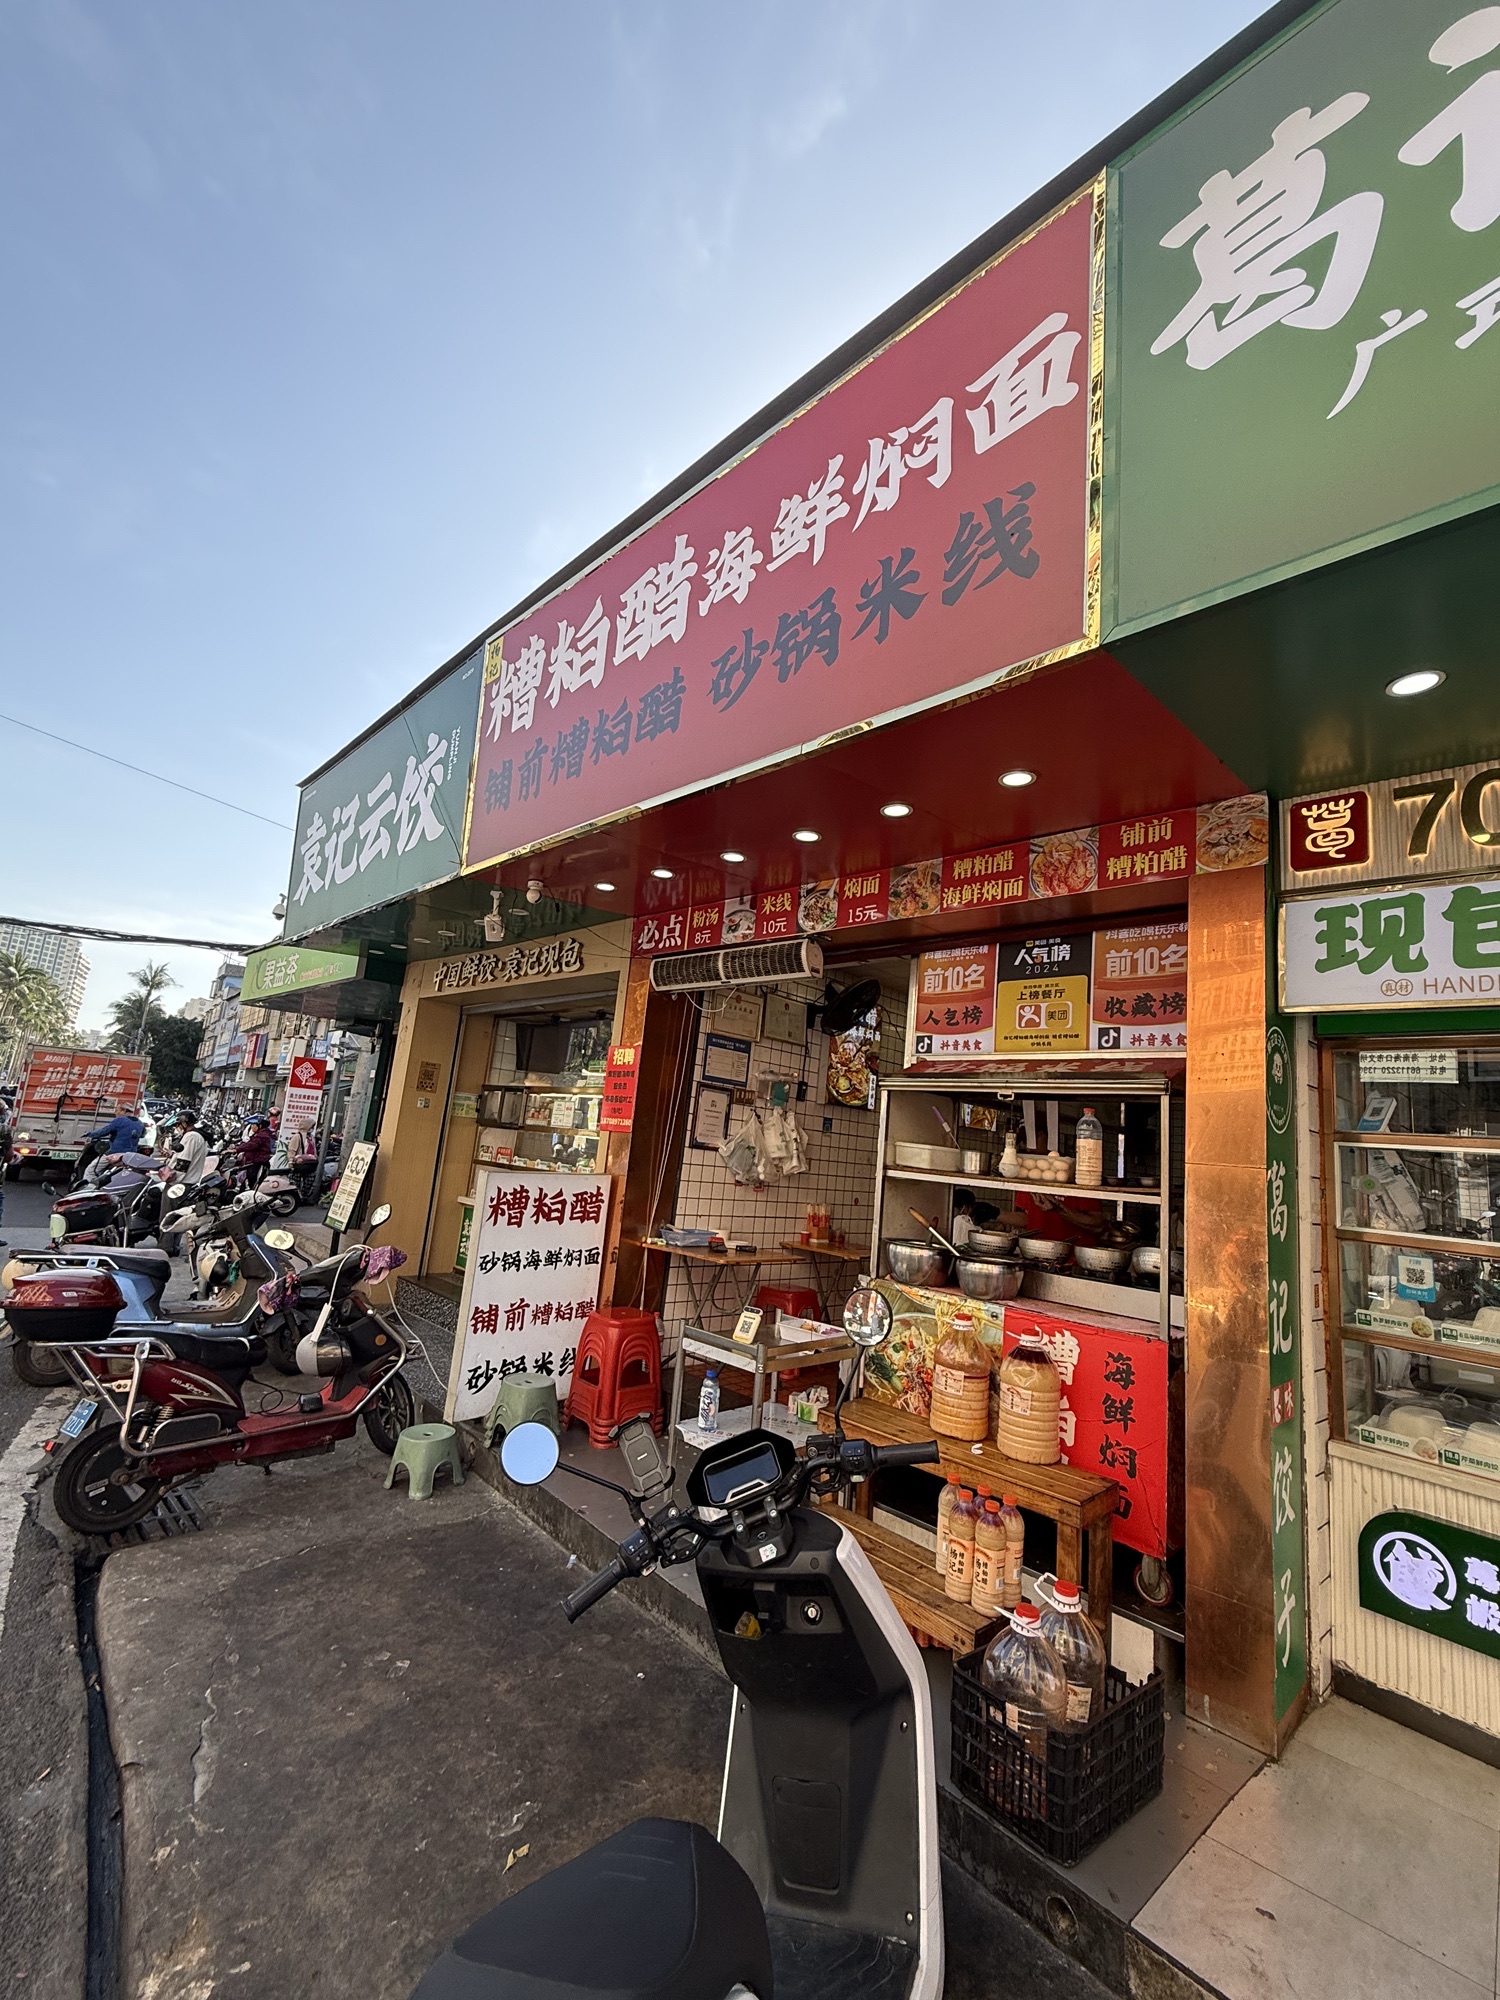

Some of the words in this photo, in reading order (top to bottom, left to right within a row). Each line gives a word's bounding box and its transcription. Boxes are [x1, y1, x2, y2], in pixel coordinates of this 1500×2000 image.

[486, 311, 1083, 743] 糟粕醋海鲜焖面
[484, 667, 688, 815] 铺前糟粕醋
[708, 481, 1042, 713] 砂锅米线
[293, 732, 449, 906] 袁记云饺
[1119, 816, 1175, 848] 铺前
[952, 850, 1015, 880] 糟粕醋
[1105, 845, 1189, 881] 糟粕醋
[843, 873, 880, 899] 焖面
[942, 875, 1025, 908] 海鲜焖面
[761, 892, 792, 915] 米线
[847, 904, 878, 923] 15元
[692, 908, 719, 929] 粉汤
[762, 917, 787, 935] 10元
[637, 914, 684, 951] 必点
[694, 931, 711, 945] 8元
[1014, 944, 1071, 965] 人气榜
[1105, 944, 1188, 978] 前10名
[262, 953, 300, 990] 果益茶
[924, 964, 985, 993] 前10名
[1025, 964, 1059, 975] 2024
[1017, 988, 1066, 1001] 上榜餐厅
[1423, 974, 1500, 995] HAND
[1047, 1010, 1067, 1021] 美团
[1104, 992, 1187, 1018] 收藏榜
[940, 1039, 982, 1051] 抖音美食
[1129, 1033, 1187, 1047] 抖音美食
[612, 1047, 635, 1066] 招聘
[485, 1184, 605, 1228] 糟粕醋
[478, 1247, 601, 1275] 砂锅海鲜焖面
